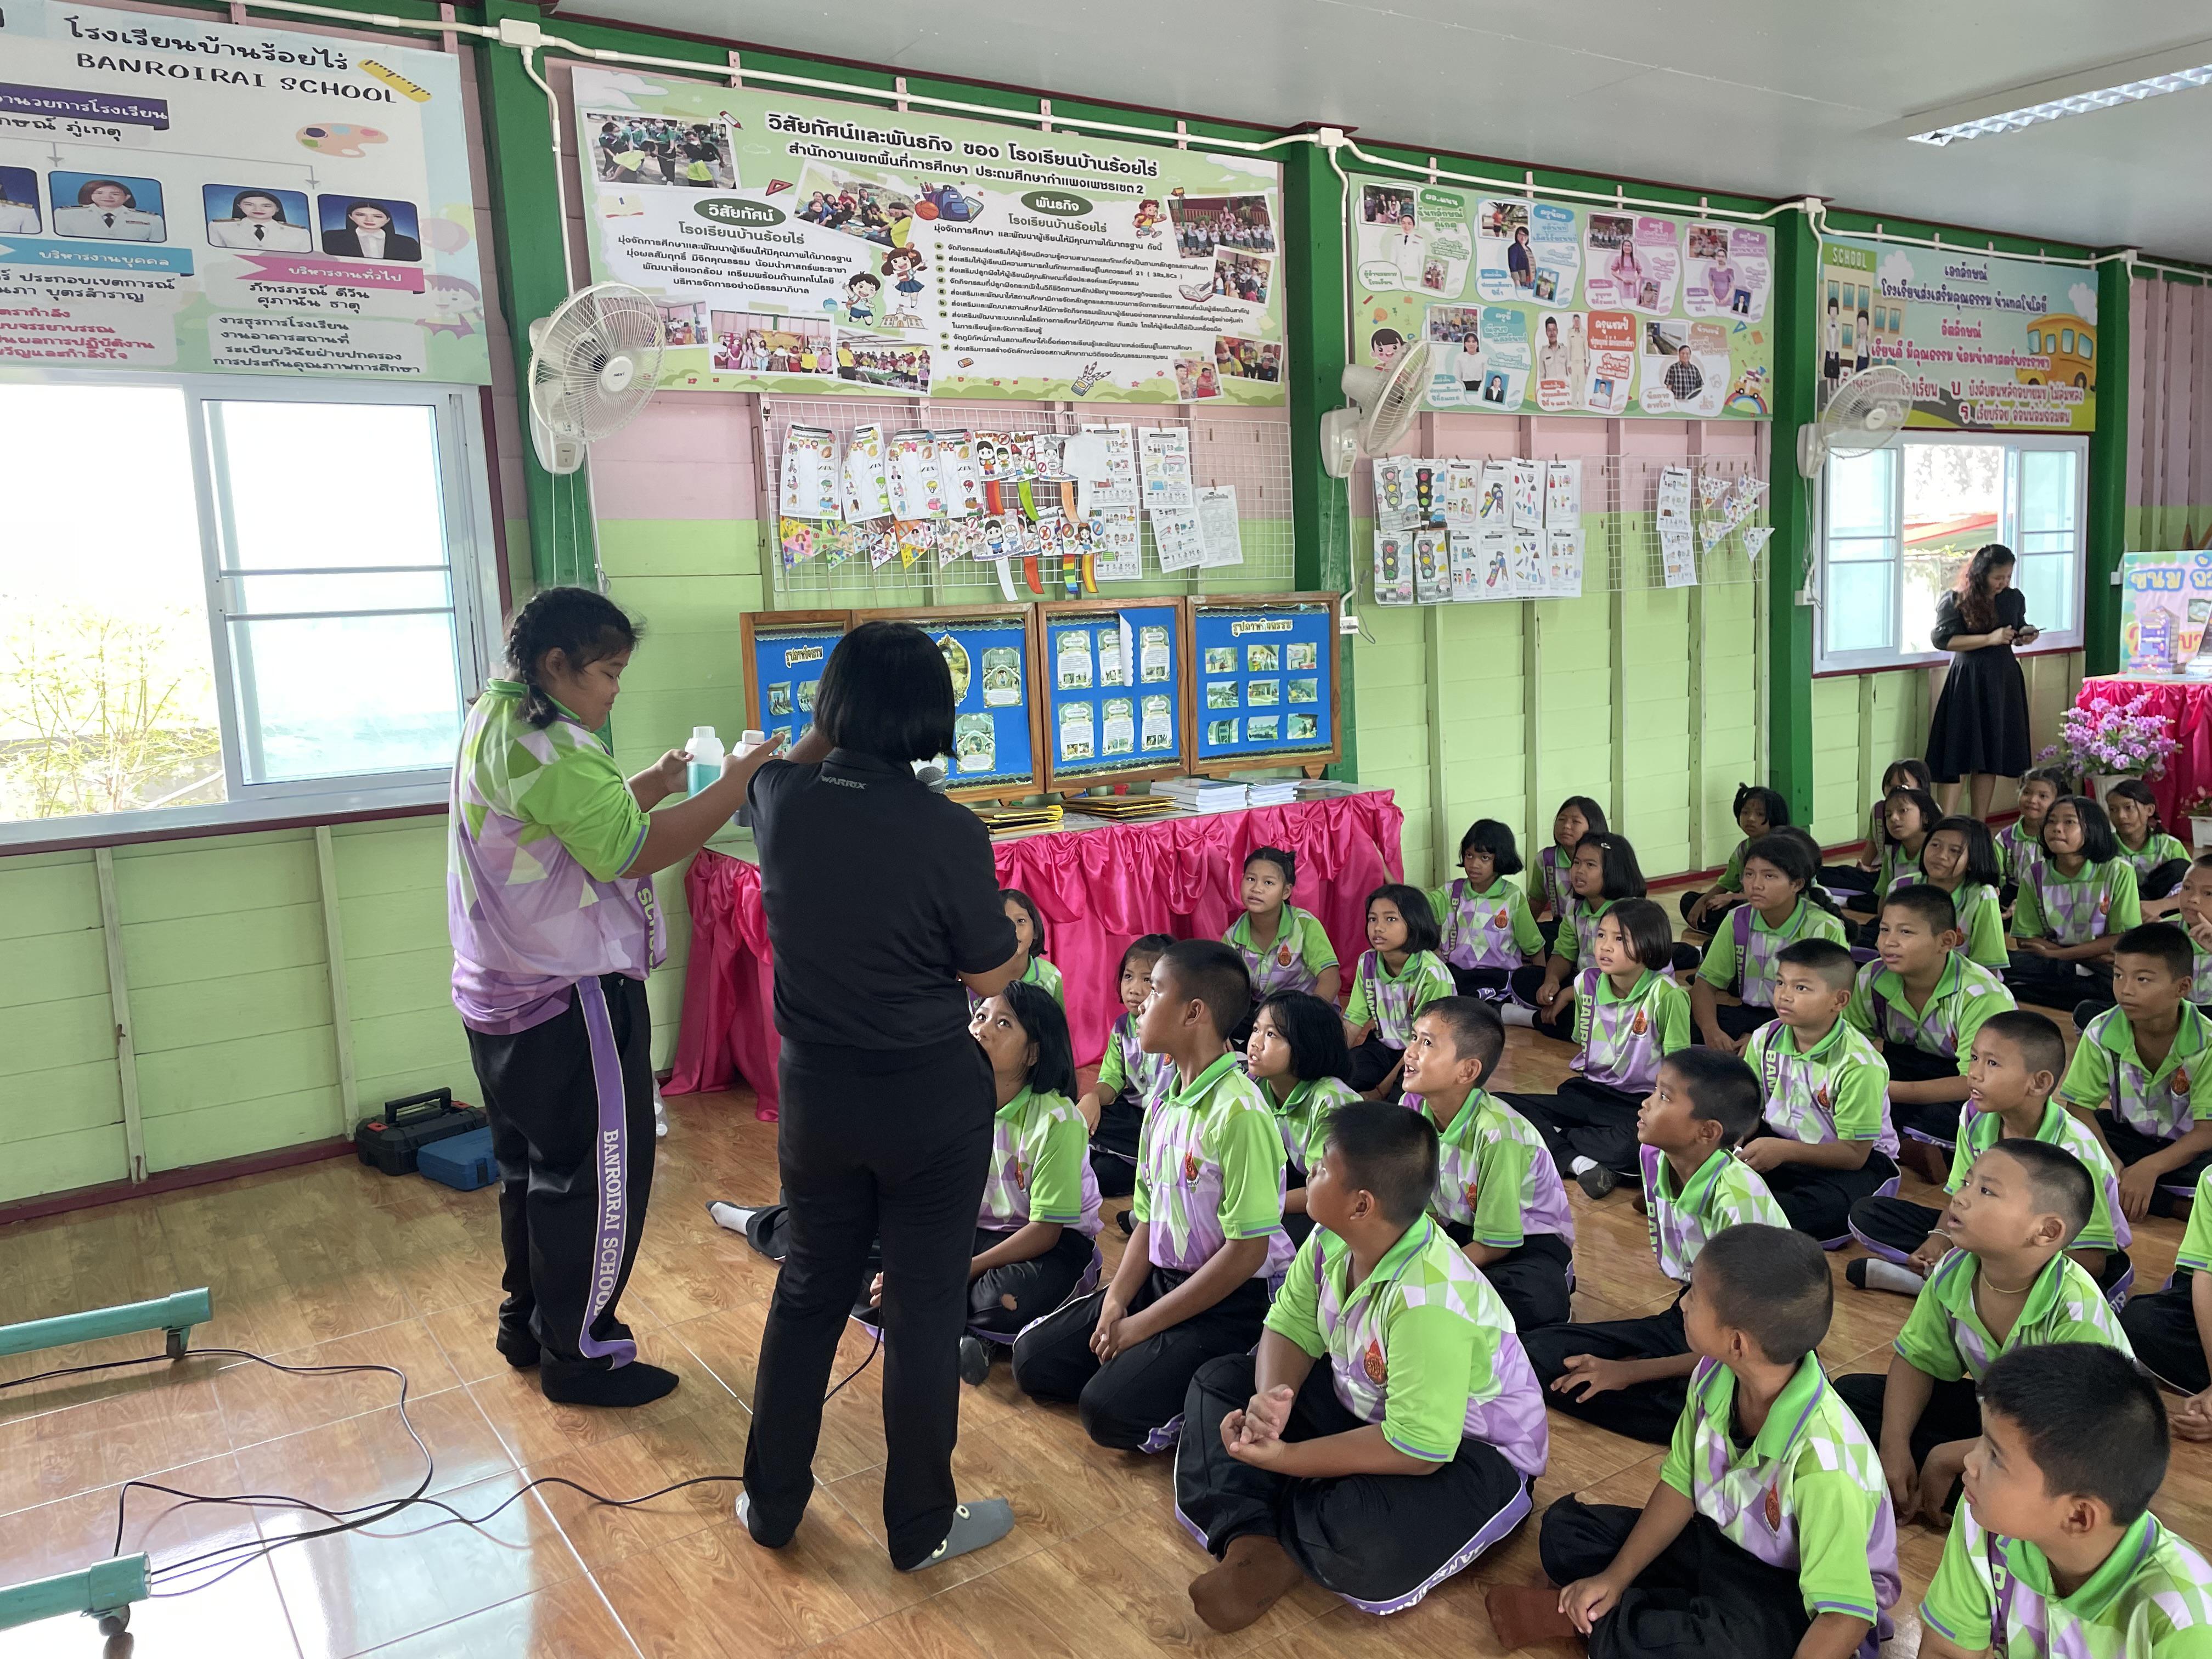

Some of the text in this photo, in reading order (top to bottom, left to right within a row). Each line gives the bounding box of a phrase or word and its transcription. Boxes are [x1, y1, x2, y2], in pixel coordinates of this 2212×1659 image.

[64, 15, 348, 71] โรงเรียนบ้านร้อยไร่
[77, 53, 397, 104] BANROIRAI SCHOOL
[769, 114, 1158, 177] วิสัยทัศน์และพันธกิจ ของ โรงเรียนบ้านร้อยไร่
[789, 142, 968, 174] สำนักงานเขตพื้นที่การศึกษา
[1136, 185, 1144, 194] 2
[709, 204, 774, 222] วิสัยทัศน์
[1036, 195, 1080, 211] พันธกิจ
[679, 222, 805, 244] โรงเรียนบ้านร้อยไร่
[934, 223, 994, 236] มุ่งจัดการศึกษา
[1008, 213, 1107, 233] โรงเรียนบ้านร้อยไร่
[39, 250, 170, 267] บริหารงานบุคคล
[1833, 247, 1866, 268] SCHOOL
[289, 265, 401, 282] บริหารงานทั่วไป
[821, 775, 867, 789] WARRIX
[603, 1129, 622, 1231] BANROIRAI
